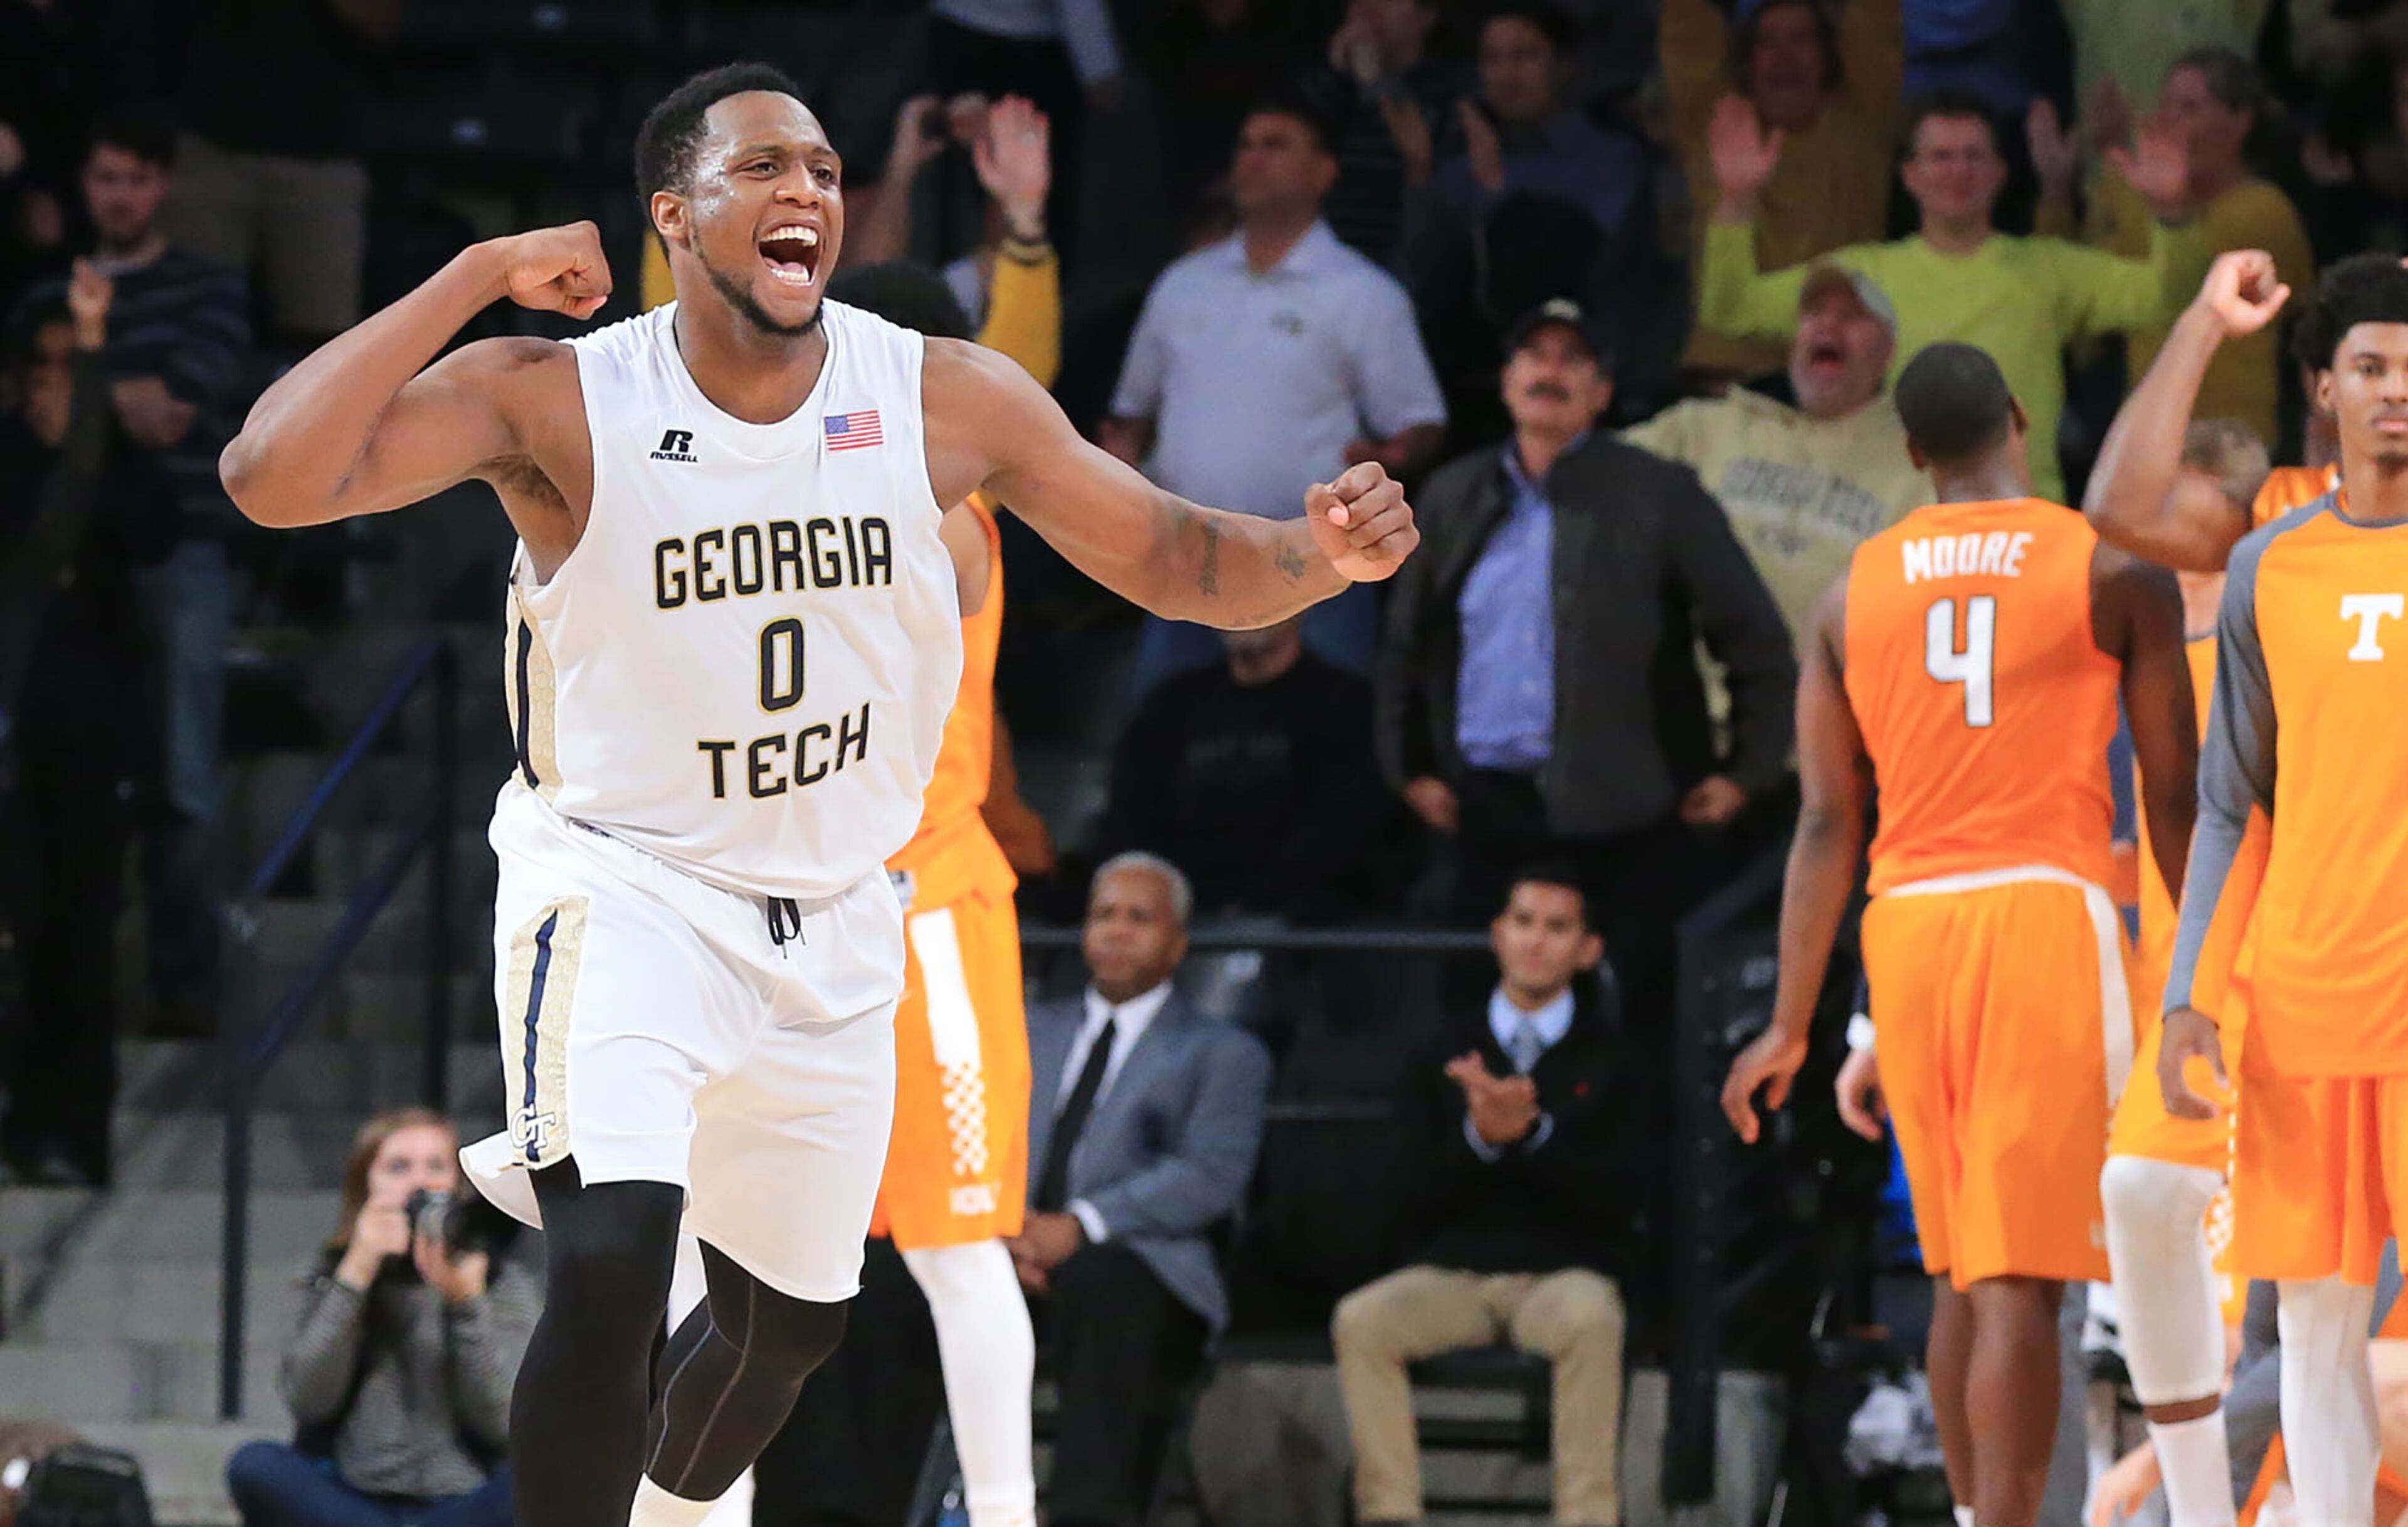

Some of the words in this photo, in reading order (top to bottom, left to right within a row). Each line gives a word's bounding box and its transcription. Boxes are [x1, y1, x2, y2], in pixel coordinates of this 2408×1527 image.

[650, 451, 699, 463] RUSSELL
[653, 515, 894, 611] GEORGIA
[1902, 531, 2034, 584] MOORE
[759, 616, 805, 714] 0
[1925, 594, 1996, 727] 4
[2340, 593, 2405, 662] T
[697, 700, 872, 800] TECH
[510, 1102, 556, 1149] GT
